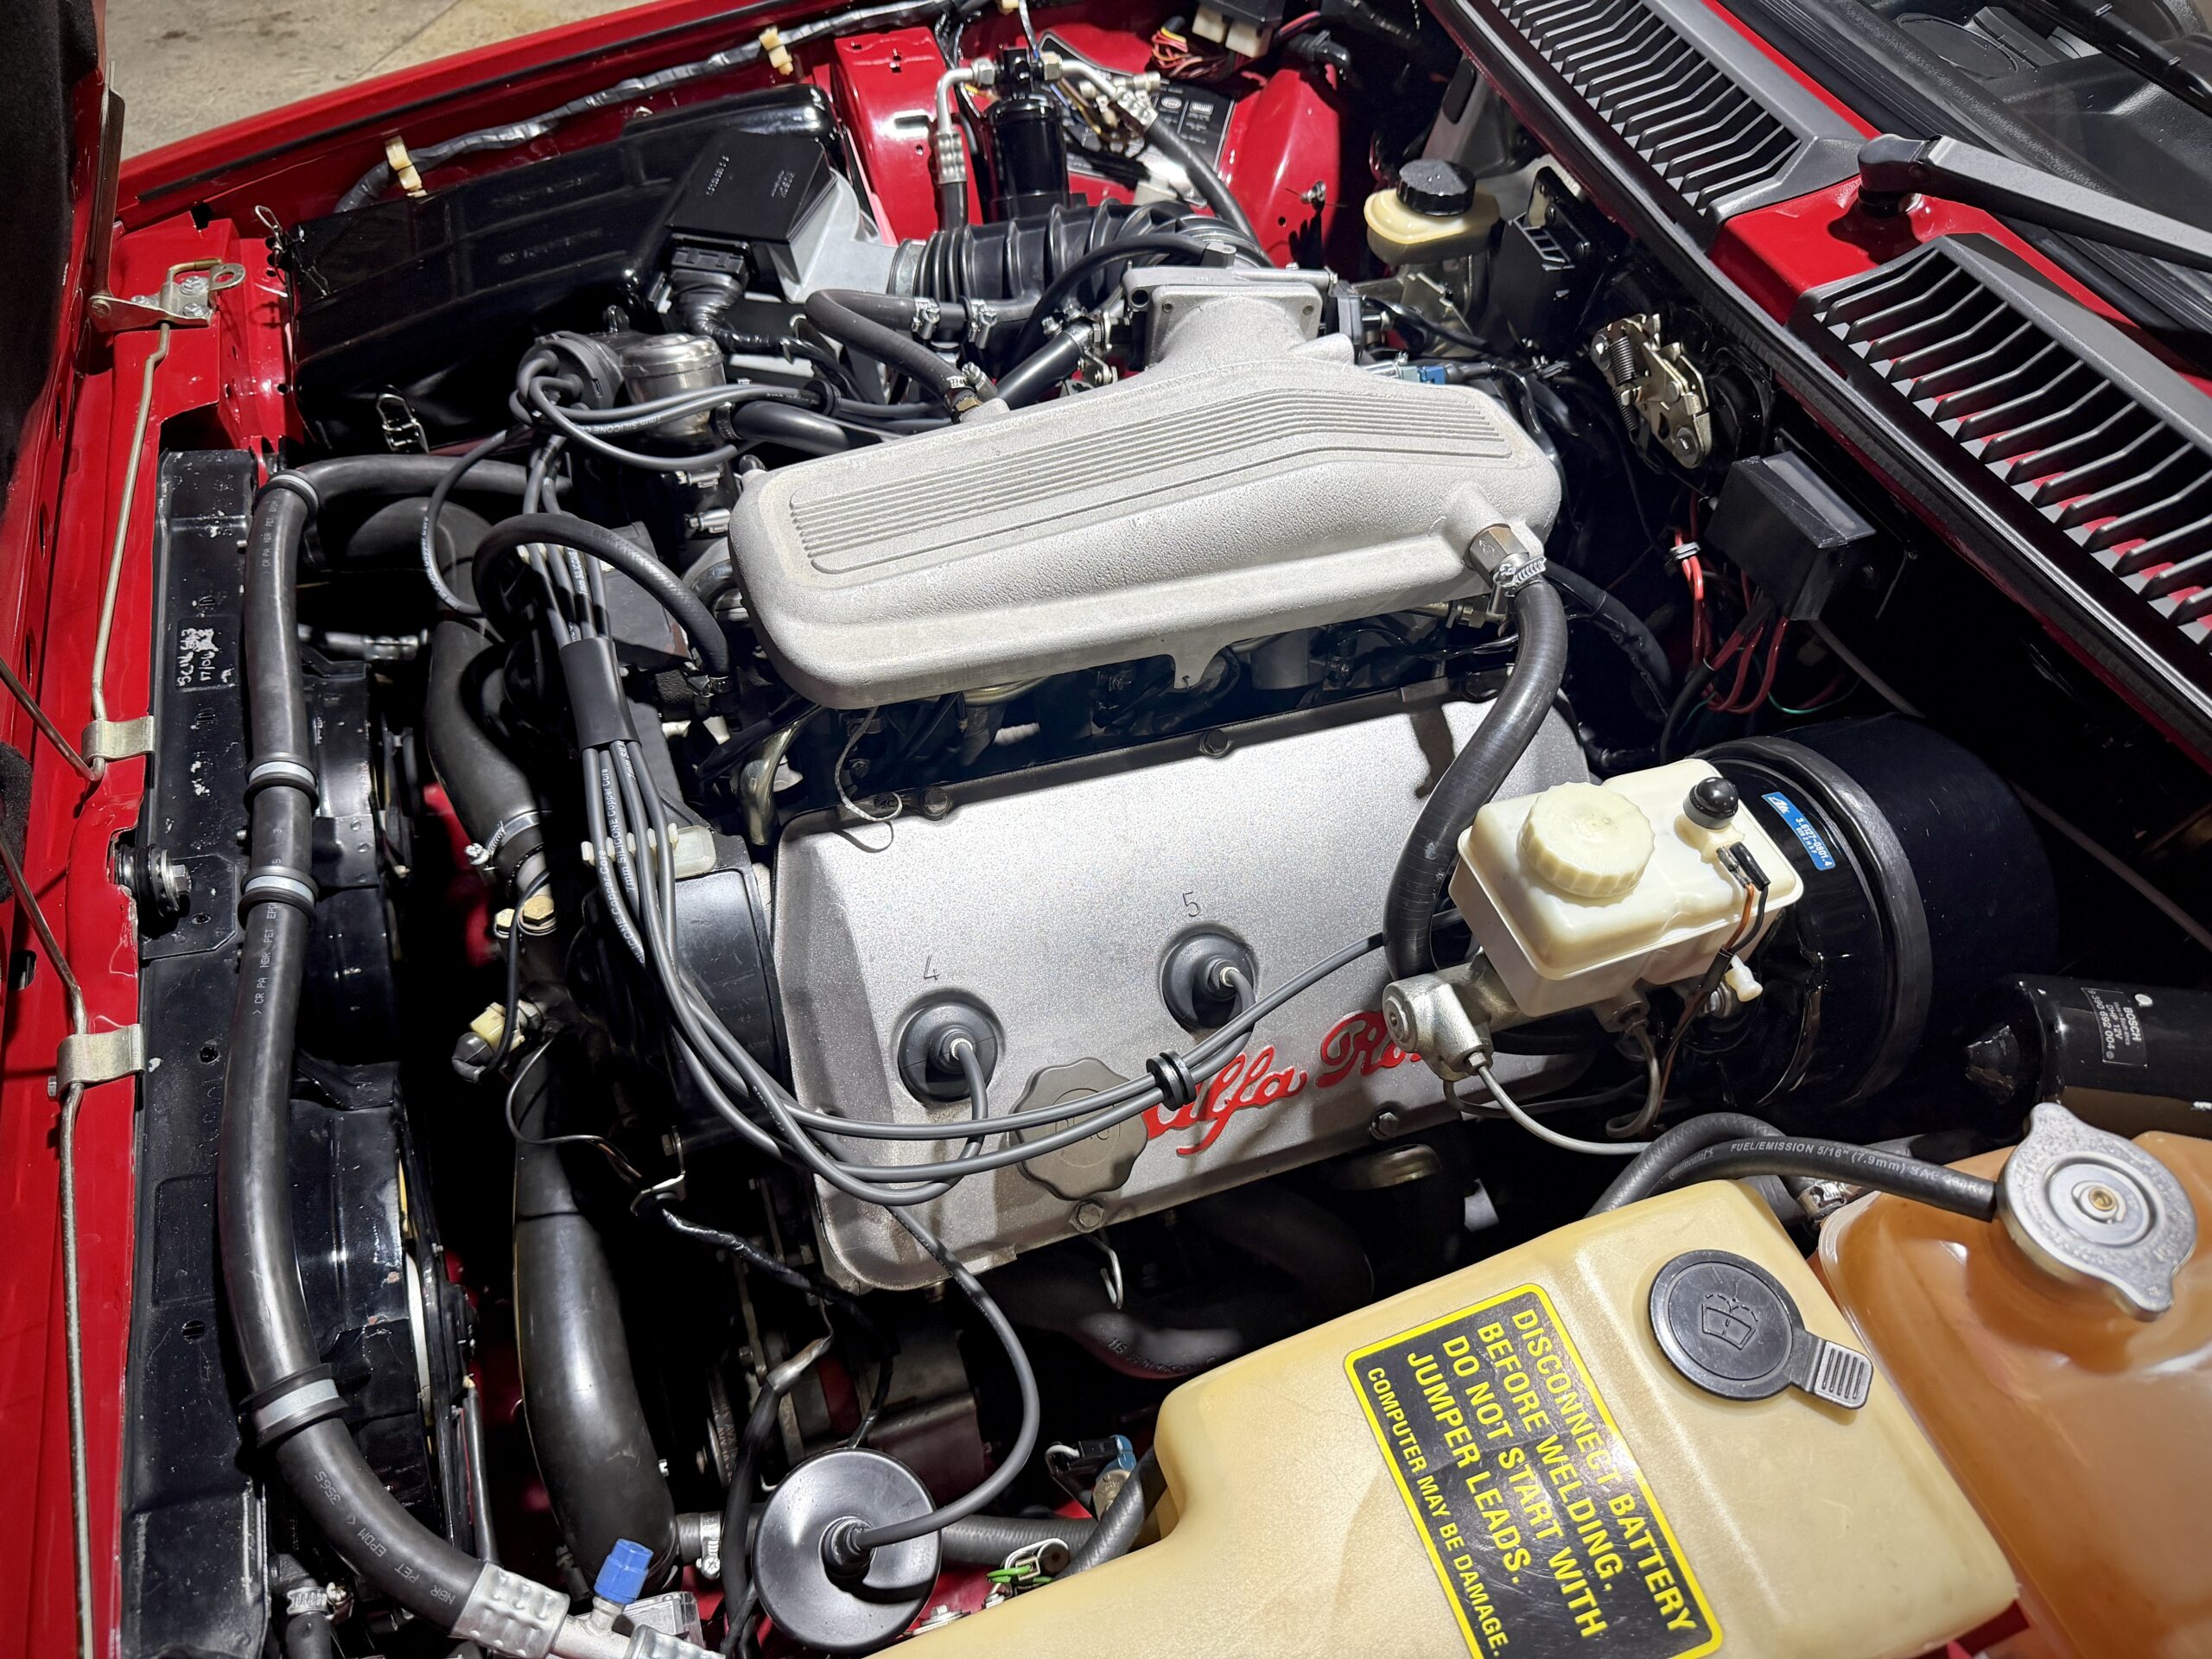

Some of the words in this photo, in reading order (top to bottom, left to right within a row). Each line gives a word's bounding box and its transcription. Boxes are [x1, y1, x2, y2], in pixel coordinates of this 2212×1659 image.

[601, 768, 612, 787] Core
[604, 787, 617, 817] Copper
[608, 817, 628, 864] SILICONE
[598, 849, 610, 874] Core
[604, 877, 622, 916] Copper
[1181, 890, 1199, 917] 5
[267, 902, 277, 919] EPD
[264, 929, 275, 943] PET
[259, 951, 271, 968] NBR
[922, 955, 939, 980] 4
[257, 977, 268, 988] PA
[254, 992, 265, 1004] CR
[2100, 1010, 2112, 1029] 692
[2113, 1024, 2124, 1040] 12V
[2123, 1007, 2142, 1043] BOSCH
[2104, 1030, 2115, 1050] 004
[1731, 1138, 1815, 1154] FUEL/EMISSION
[1816, 1145, 1850, 1160] 5/16"
[1851, 1151, 1908, 1175] (7.9mm)
[1407, 1352, 1481, 1468] JUMPER
[1467, 1471, 1532, 1584] LEADS.
[1478, 1321, 1551, 1432] BEFORE
[1535, 1434, 1624, 1591] WELDING.
[1512, 1308, 1623, 1485] DISCONNECT
[1607, 1493, 1698, 1631] BATTERY
[1443, 1335, 1481, 1377] DO
[1465, 1377, 1513, 1442] NOT
[1498, 1446, 1564, 1540] START
[1548, 1547, 1607, 1637] WITH
[1368, 1367, 1427, 1473] COMPUTER
[1417, 1475, 1451, 1518] MAY
[1440, 1522, 1464, 1552] BE
[1454, 1553, 1510, 1657] DAMAGE.
[357, 1528, 387, 1557] EPDM
[394, 1562, 421, 1584] PET
[429, 1585, 456, 1605] NBR
